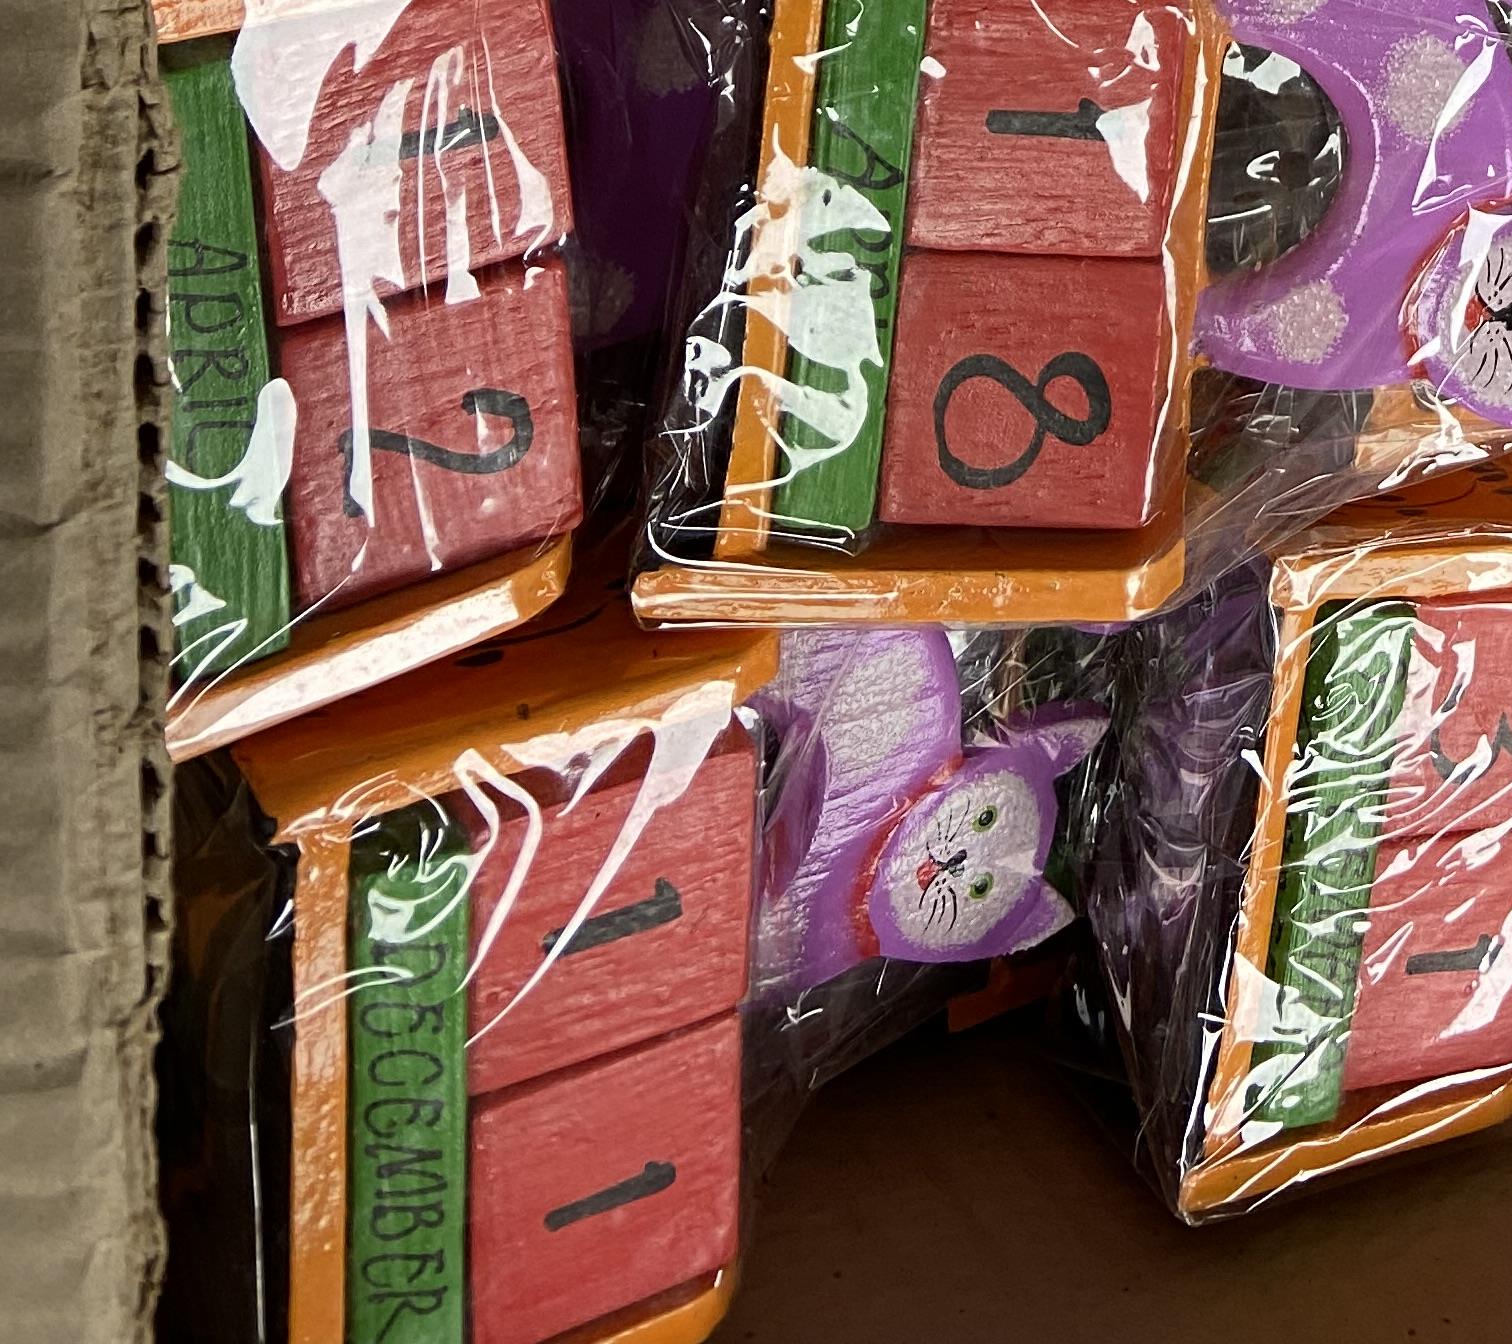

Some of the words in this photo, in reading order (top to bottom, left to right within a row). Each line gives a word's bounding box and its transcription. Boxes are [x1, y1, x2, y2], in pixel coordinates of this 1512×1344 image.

[985, 97, 1106, 141] 1
[168, 238, 256, 476] APRIL
[338, 387, 534, 518] 2
[932, 351, 1112, 490] 8
[540, 875, 683, 958] 1
[1405, 933, 1505, 976] 1
[359, 938, 451, 1343] DECEMBER
[543, 1159, 678, 1233] 1
